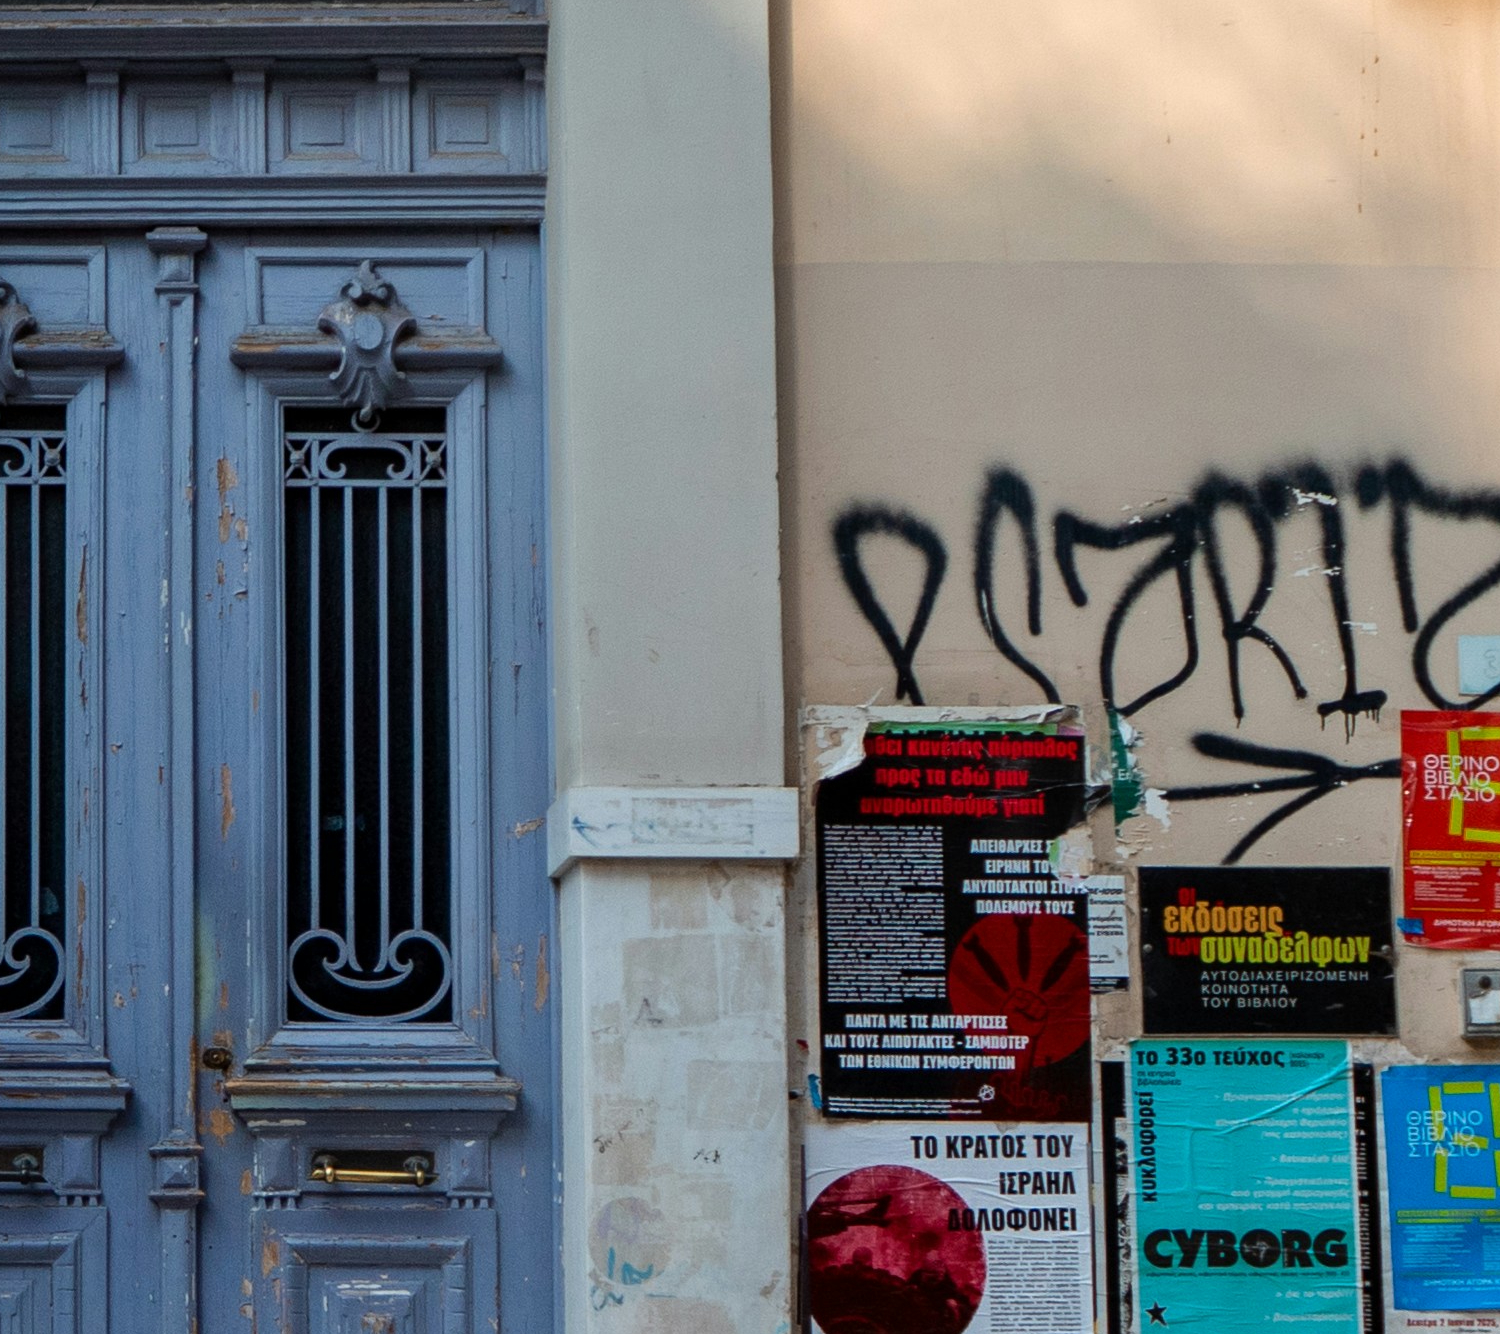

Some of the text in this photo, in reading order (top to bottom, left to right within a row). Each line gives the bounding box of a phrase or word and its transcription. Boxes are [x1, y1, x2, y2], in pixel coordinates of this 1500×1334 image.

[908, 736, 1078, 760] κανένας πύραυλος
[1424, 755, 1500, 771] ΘΕΡΙΝΟ
[875, 765, 1029, 788] προς τα εδώ μην
[1424, 771, 1491, 786] ΒΙΒΛΙΟ
[1424, 786, 1496, 802] ΣΤΑΣΙΟ
[1002, 794, 1046, 818] γιατί
[970, 839, 1044, 854] ΑΠΕΙΘΑΡΧΕΣ
[985, 860, 1030, 874] ΕΙΡΗΝΗ
[962, 880, 1048, 895] ΑΝΥΠΟΤΑΚΤΟΙ
[976, 900, 1076, 915] ΠΟΛΕΜΟΥΣ ΤΟΥΣ
[1163, 900, 1284, 936] εκδόσεις
[1168, 931, 1371, 967] των συναδέλφων
[1201, 971, 1369, 982] ΑΥΤΟΔΙΑΧΕΙΡΙΖΟΜΕΝΗ
[1201, 984, 1289, 995] ΚΟΙΝΟΤΗΤΑ
[1202, 997, 1298, 1008] ΤΟΥ ΒΙΒΛΙΟΥ
[845, 1014, 1008, 1029] ΠΑΝΤΑ ΜΕ ΤΙΣ ΑΝΤΑΡΤΙΣΣΕΣ
[825, 1034, 1029, 1049] ΚΑΙ ΤΟΥΣ ΛΙΠΟΤΑΚΤΕΣ ΣΑΜΠΟΤΕΡ
[839, 1054, 1016, 1070] ΤΩΝ ΕΘΝΙΚΩΝ ΣΥΜΦΕΡΟΝΤΩΝ
[1136, 1050, 1159, 1066] το
[1212, 1047, 1285, 1068] τεύχος
[1406, 1110, 1483, 1125] ΘΕΡΙΝΟ
[1407, 1126, 1475, 1142] ΒΙΒΛΙΟ
[910, 1134, 1074, 1159] ΤΟ ΚΡΑΤΟΣ ΤΟΥ
[1135, 1090, 1158, 1202] κυκλοφορεί
[1408, 1142, 1481, 1157] ΣΤΑΣΙΟ
[999, 1170, 1076, 1195] ΙΣΡΑΗΛ
[948, 1208, 1077, 1232] ΔΟΛΟΦΟΝΕΙ
[1143, 1228, 1349, 1269] CYBORG
